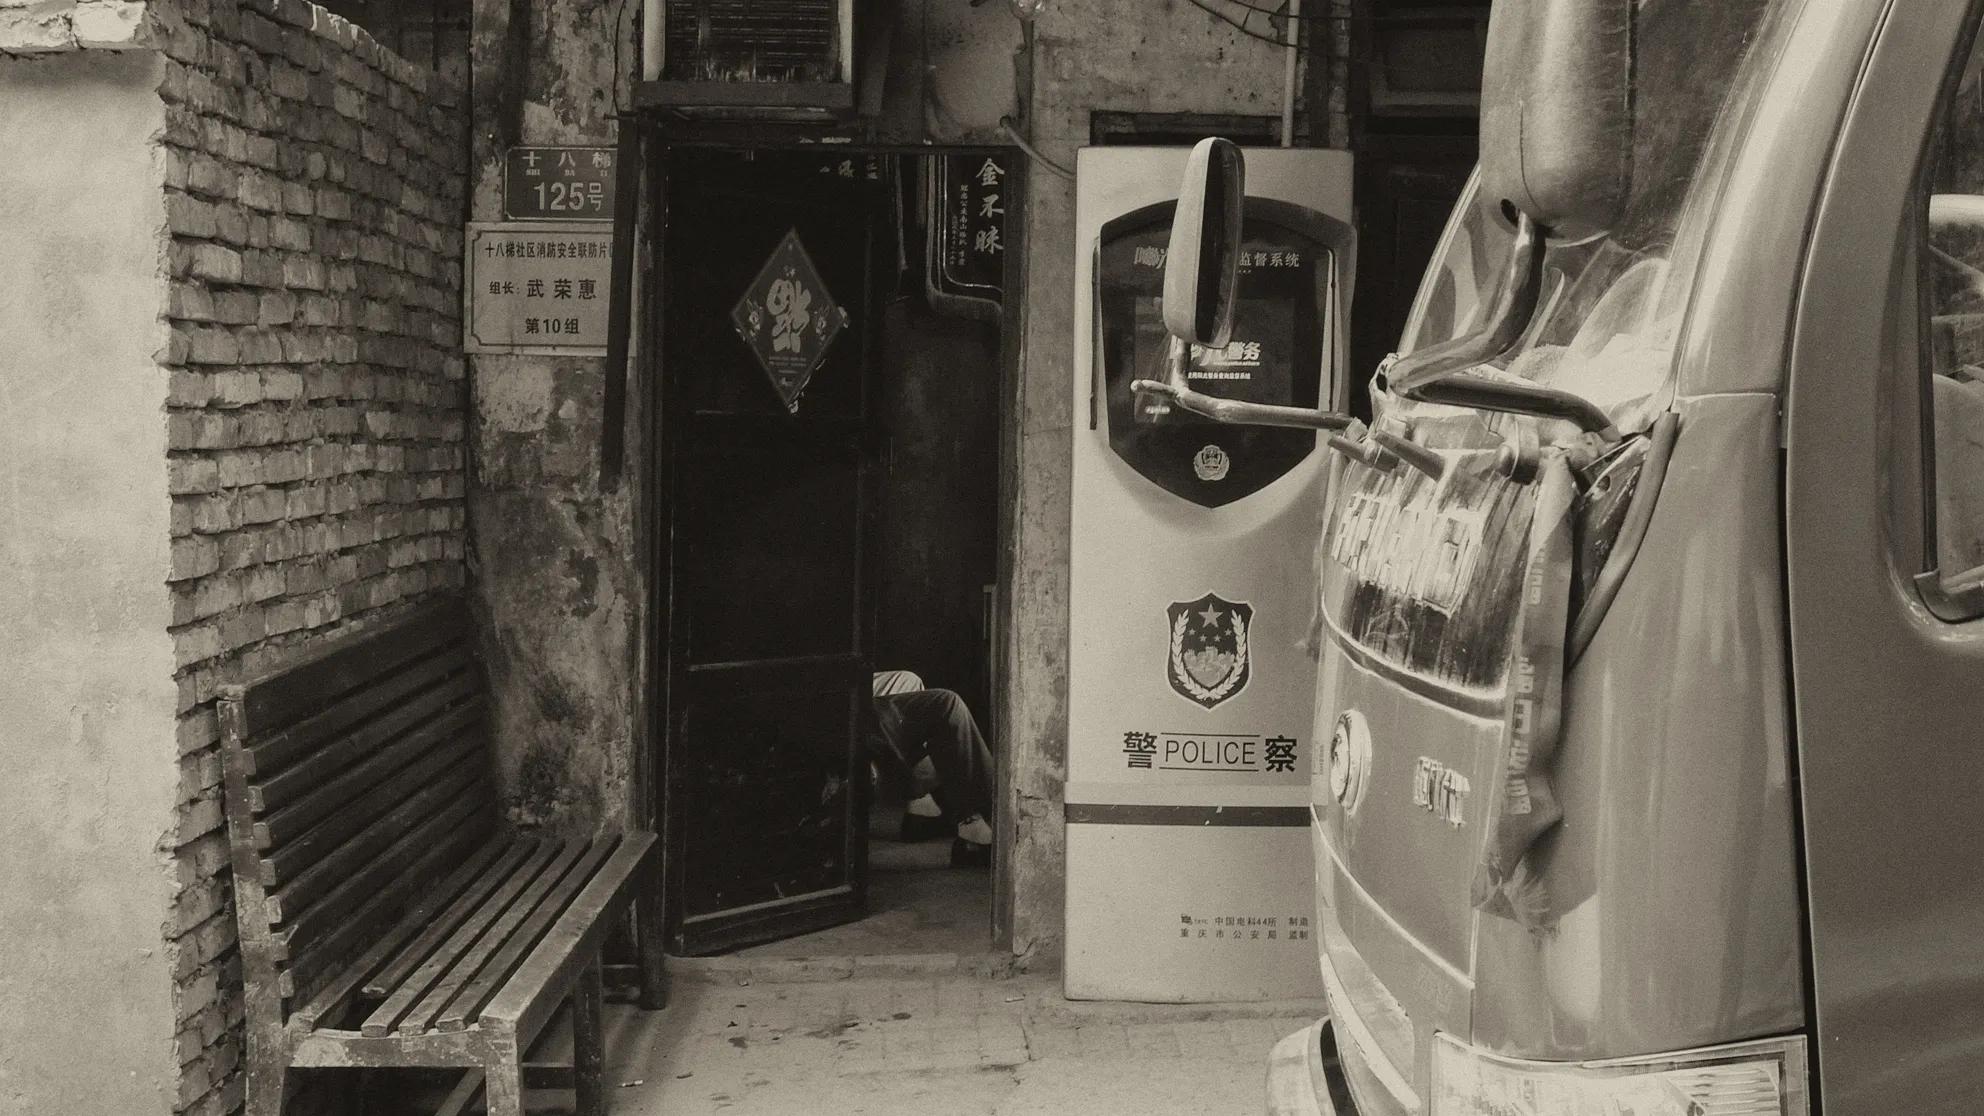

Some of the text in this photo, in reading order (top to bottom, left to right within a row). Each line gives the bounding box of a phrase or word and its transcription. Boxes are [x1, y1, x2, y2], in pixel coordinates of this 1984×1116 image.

[522, 151, 611, 167] 十八梯
[534, 182, 604, 212] 125号
[1239, 251, 1300, 268] 监督系统
[527, 279, 597, 300] 武荣惠
[525, 318, 580, 335] 第10组
[1122, 731, 1158, 769] 警
[1165, 740, 1256, 765] POLICE
[1264, 735, 1298, 773] 察
